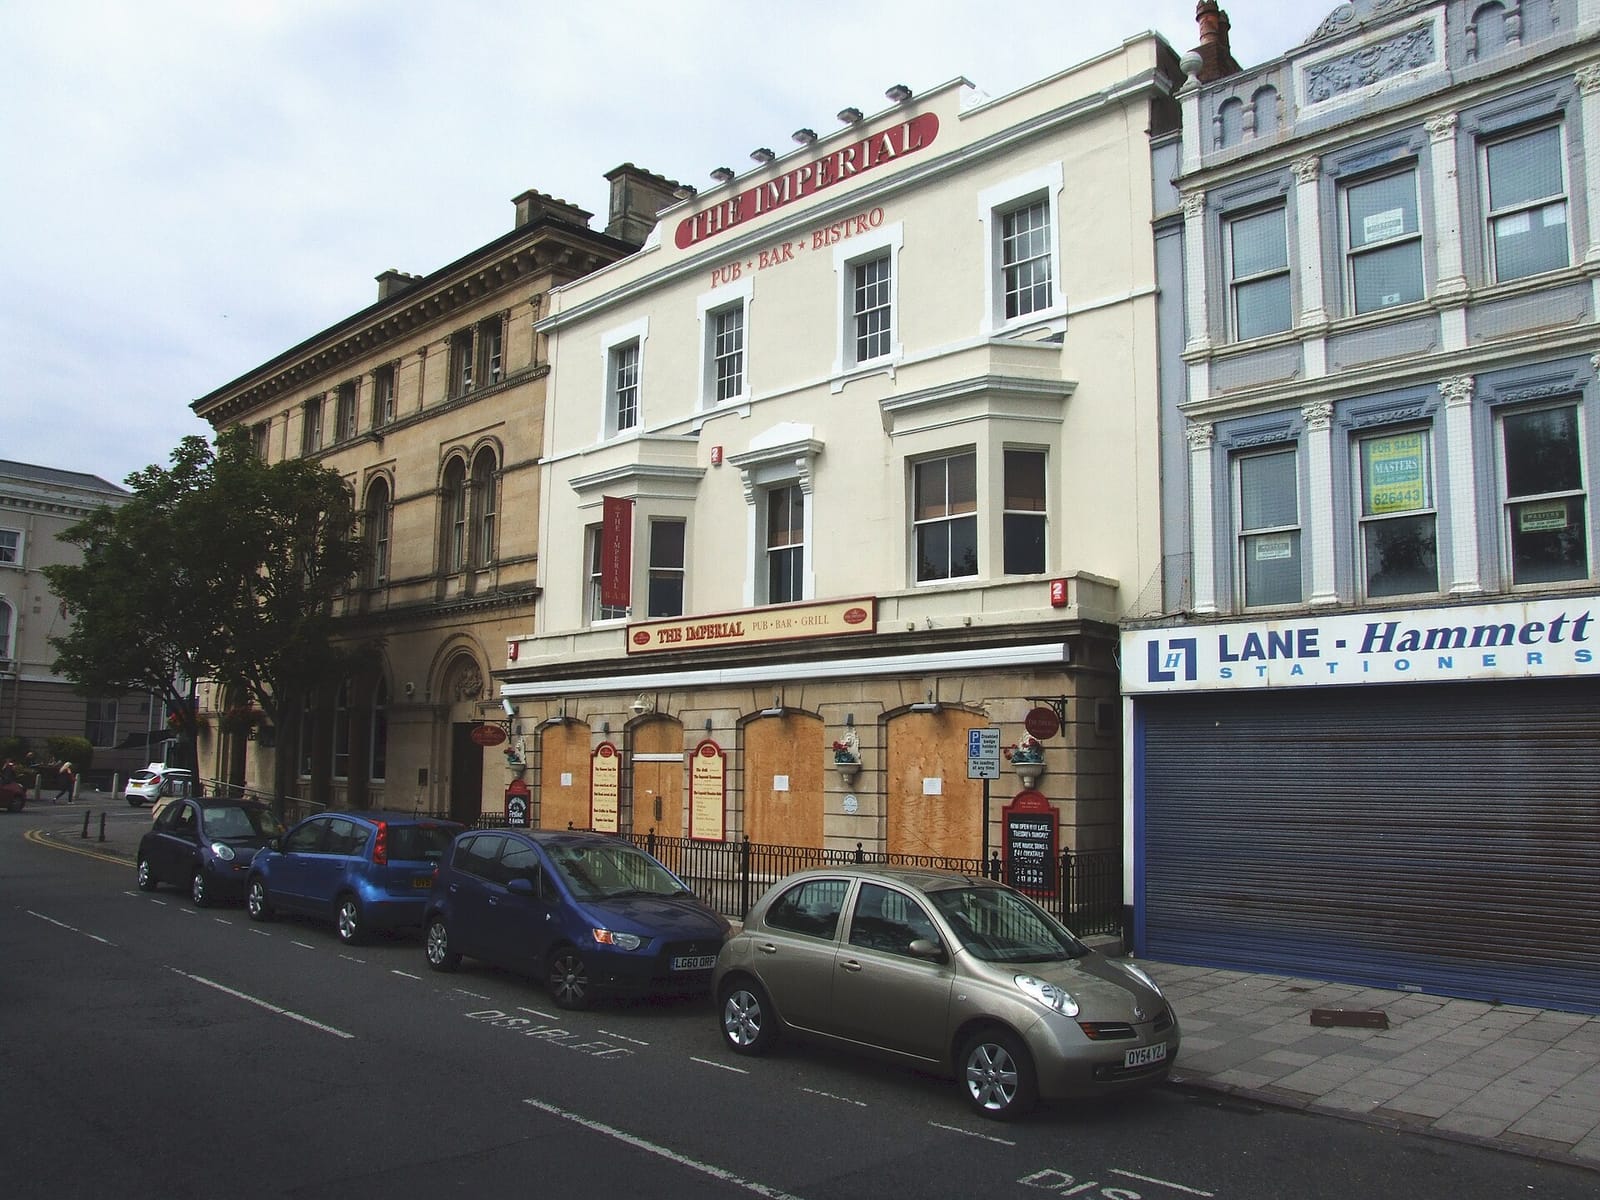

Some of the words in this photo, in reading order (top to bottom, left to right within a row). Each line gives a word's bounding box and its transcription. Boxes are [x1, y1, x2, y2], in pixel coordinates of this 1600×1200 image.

[687, 196, 742, 242] THE
[755, 122, 921, 214] IMPERIAL
[710, 265, 742, 288] PUB
[758, 242, 795, 270] BAR
[811, 206, 885, 251] BISTRO
[1394, 436, 1418, 450] SALE
[1375, 459, 1418, 473] MASTERS
[1052, 583, 1062, 595] 2
[657, 627, 682, 644] THE
[685, 621, 745, 642] IMPERIAL
[752, 620, 769, 631] PUB
[775, 618, 792, 629] BAR
[801, 614, 829, 625] GRILL
[1218, 627, 1321, 663] LANE
[1356, 609, 1596, 655] Hammett
[1219, 648, 1593, 680] STATIONERS
[972, 731, 979, 743] P
[675, 957, 699, 969] LG60
[1128, 1048, 1152, 1066] OY54
[1152, 1043, 1166, 1060] YZJ
